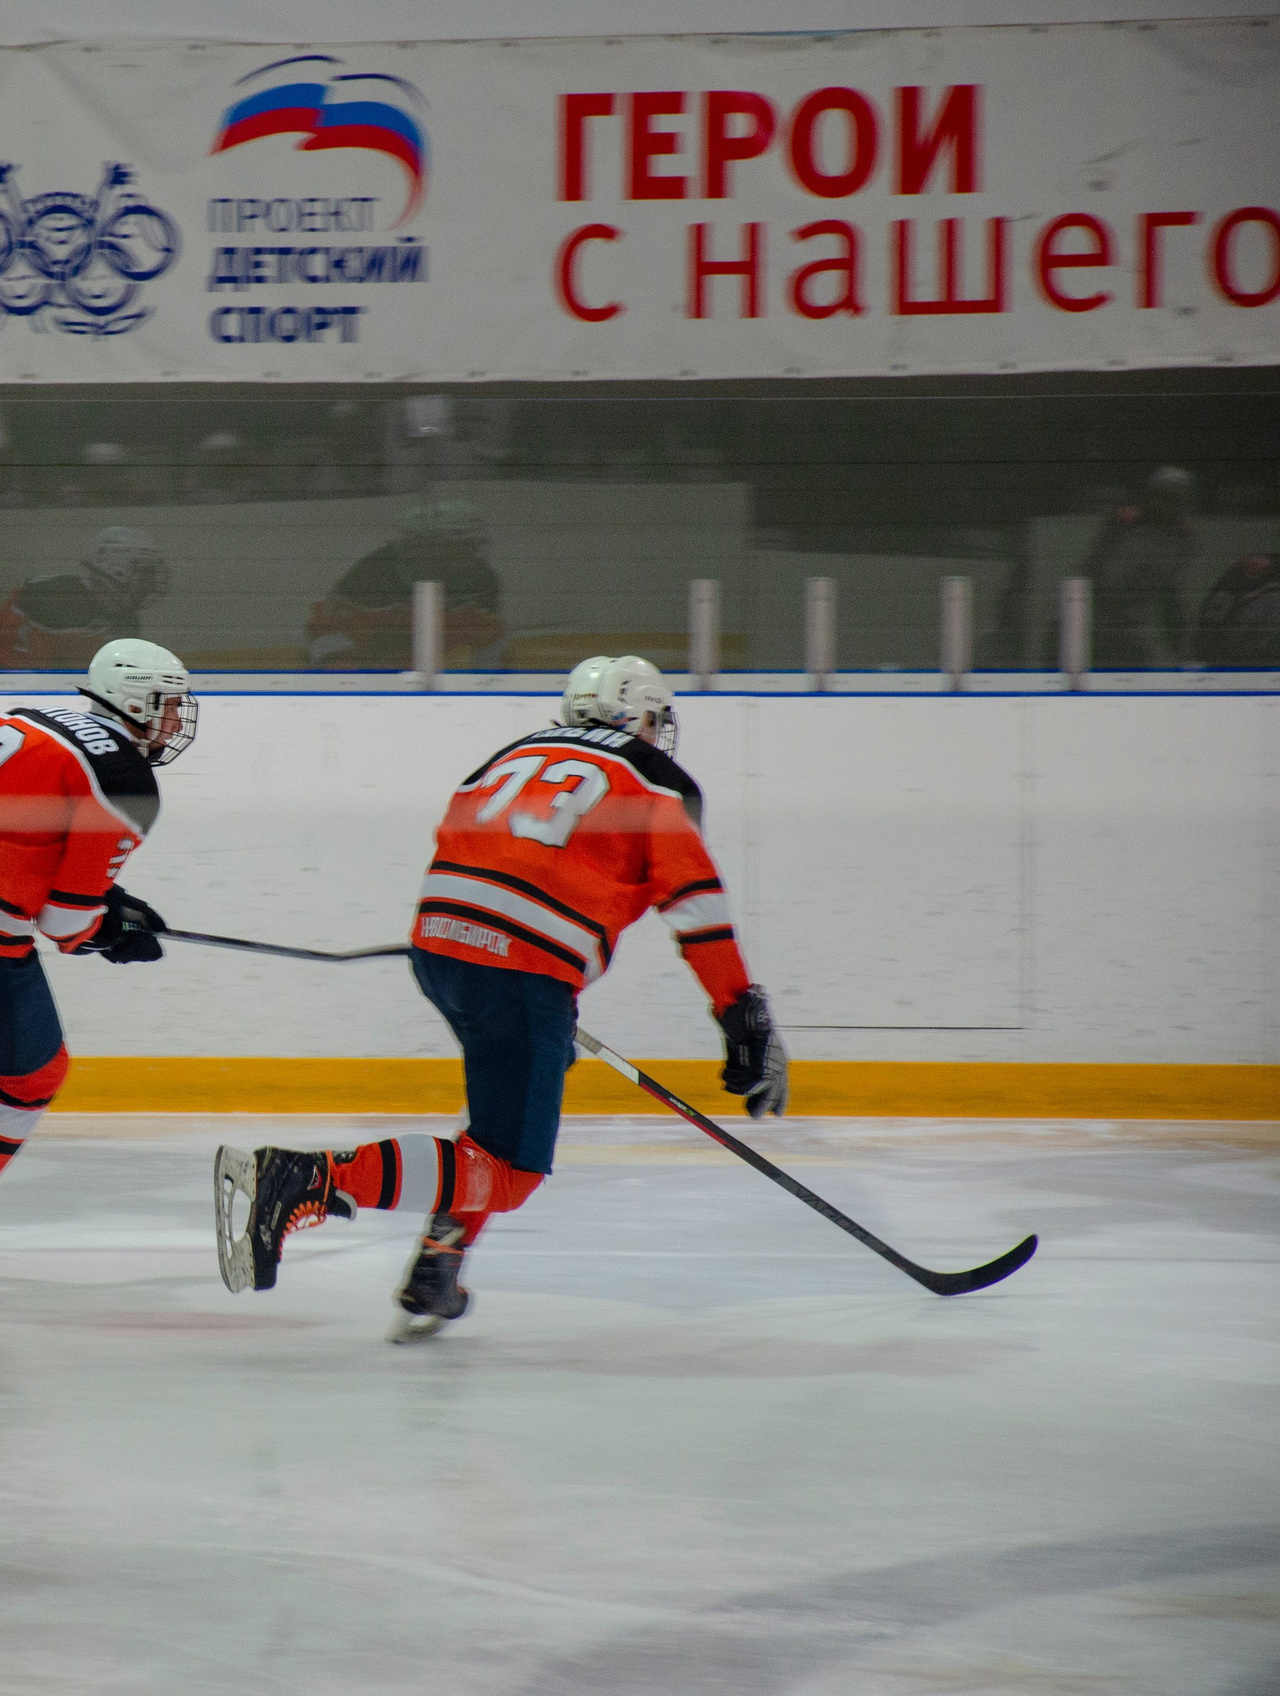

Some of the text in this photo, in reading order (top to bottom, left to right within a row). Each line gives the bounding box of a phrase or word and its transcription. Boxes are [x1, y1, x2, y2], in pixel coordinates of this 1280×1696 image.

[556, 84, 984, 202] ГЕРОИ
[208, 198, 377, 232] ПРОЕКТ
[207, 236, 428, 292] ДЕТСКИЙ
[685, 206, 1280, 320] нашего
[209, 306, 366, 343] СПОРТ
[475, 754, 610, 849] 73
